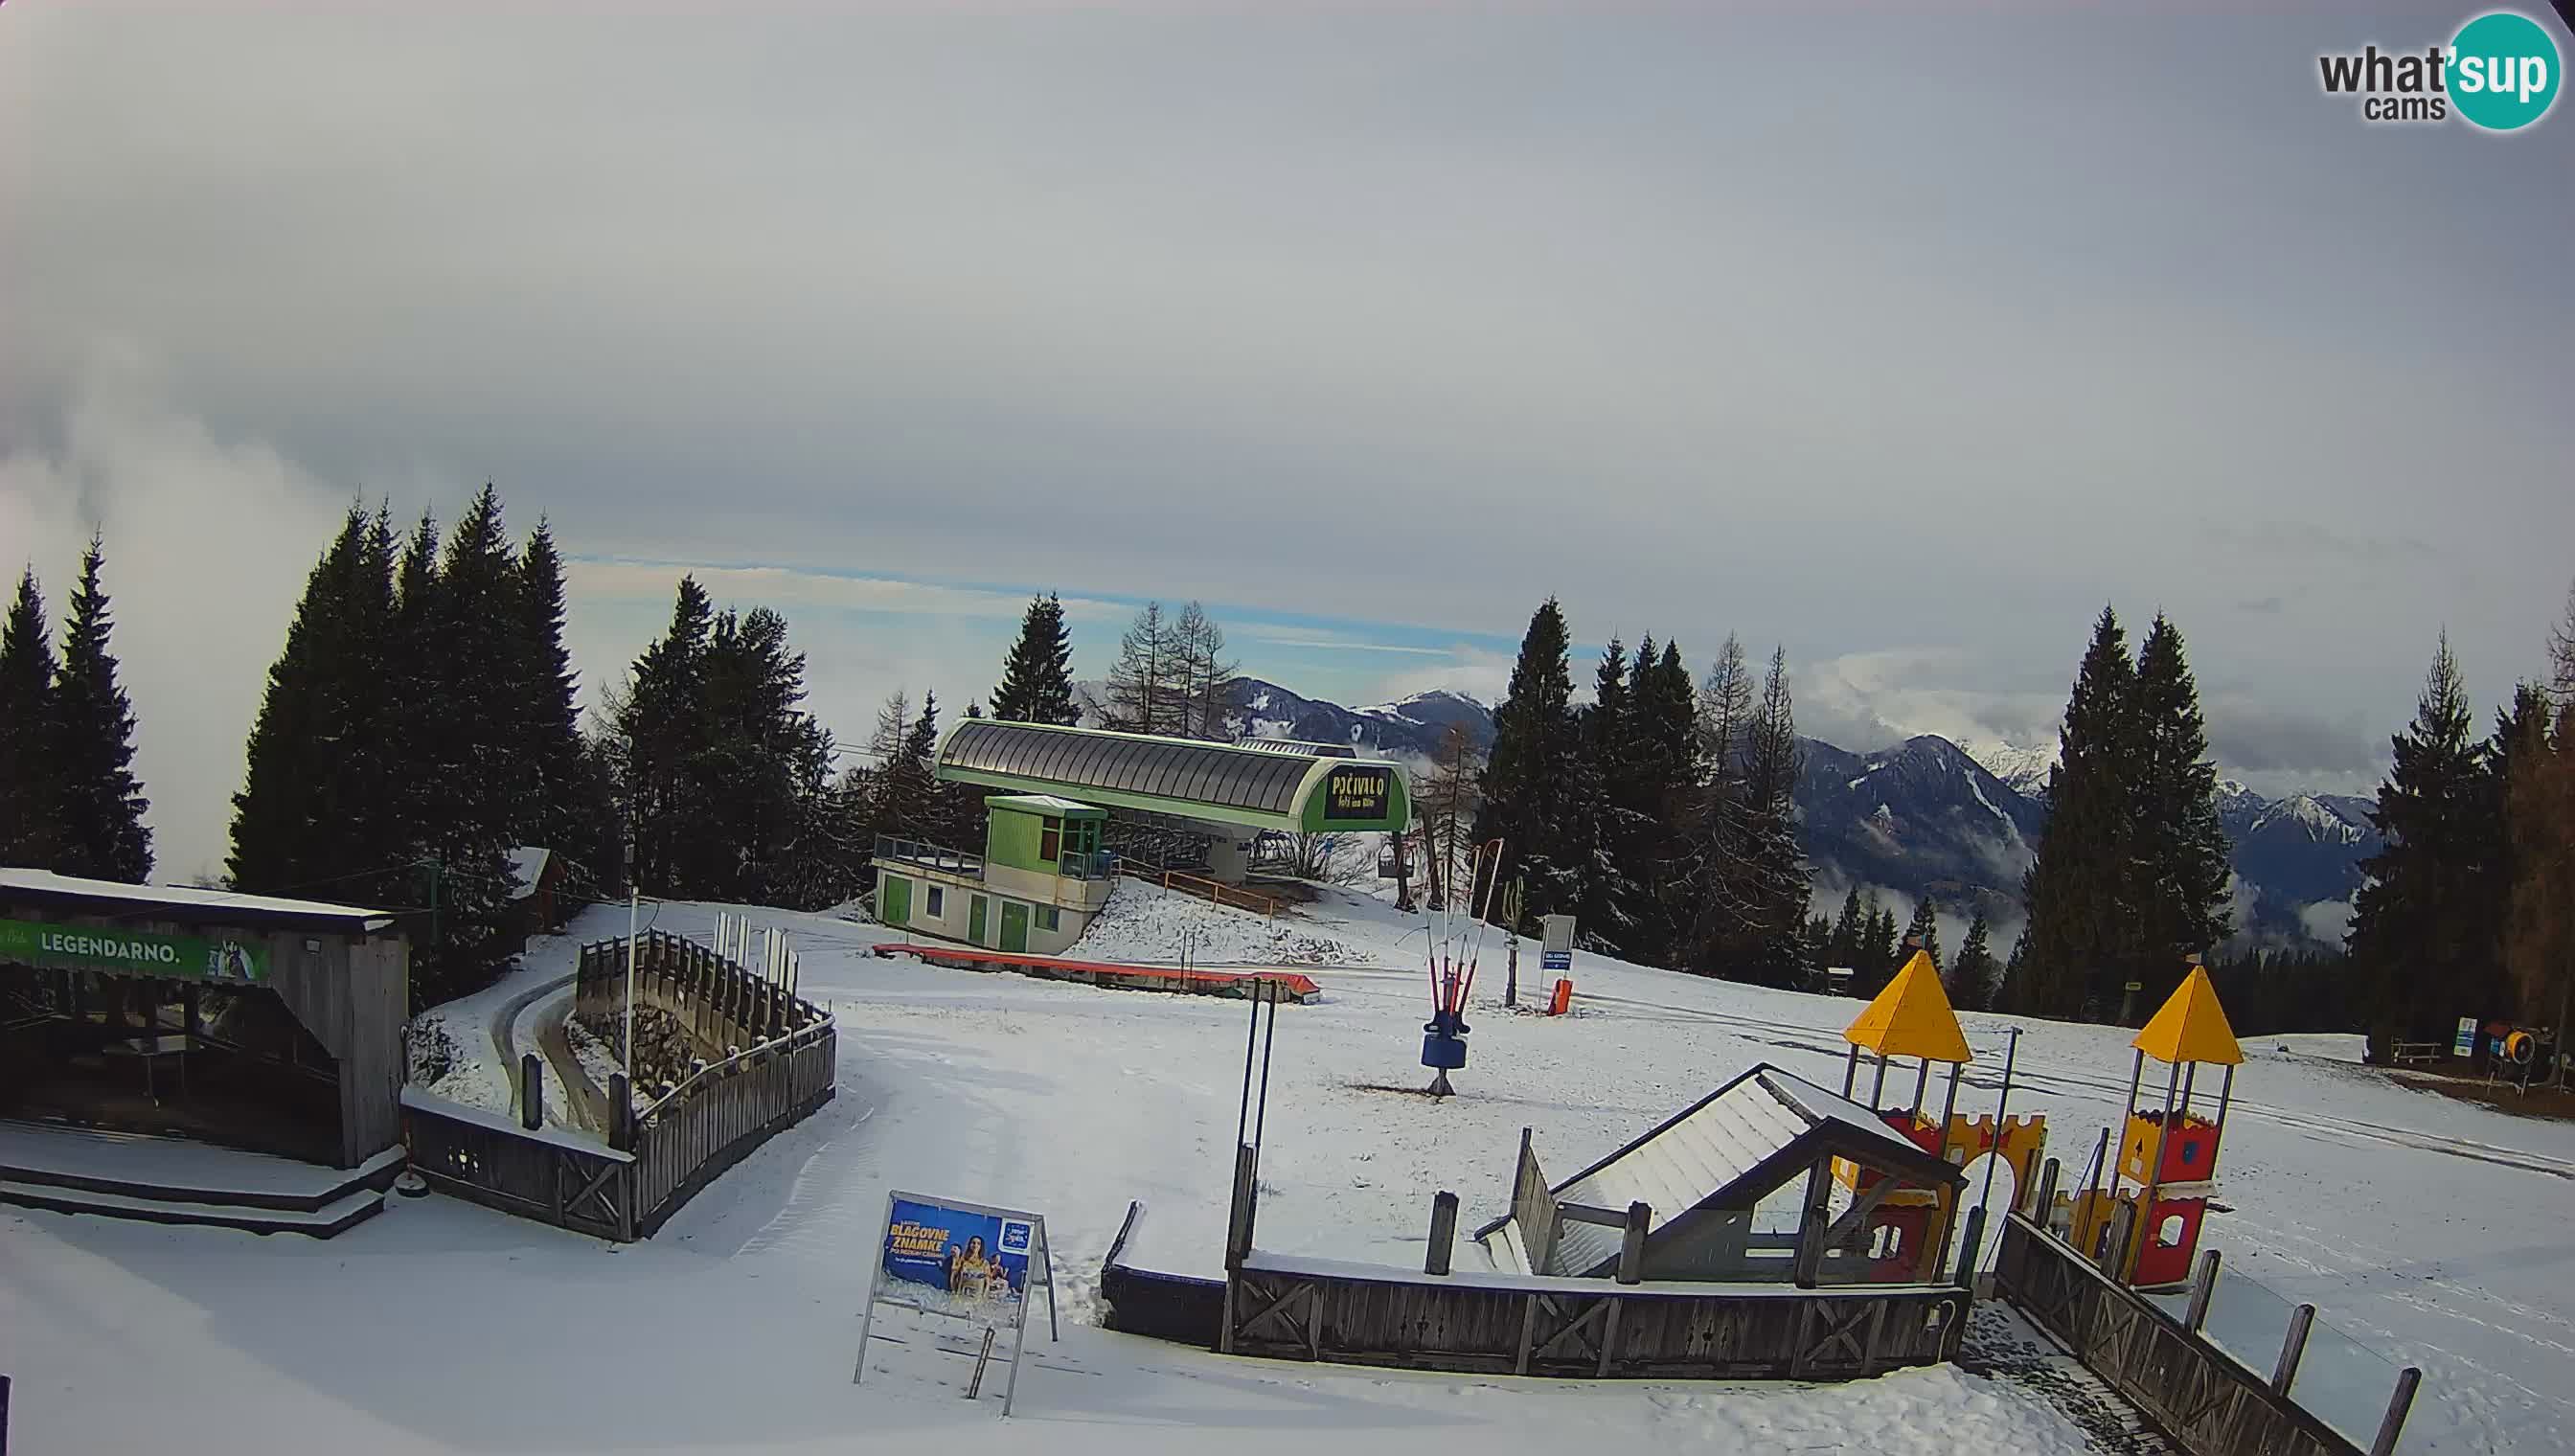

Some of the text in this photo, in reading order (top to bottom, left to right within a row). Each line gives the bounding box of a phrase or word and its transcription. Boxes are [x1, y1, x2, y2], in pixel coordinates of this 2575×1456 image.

[41, 932, 180, 964] LEGENDARNO.
[891, 1224, 950, 1240] BLAGOVNE
[893, 1237, 944, 1252] ZNAMKE
